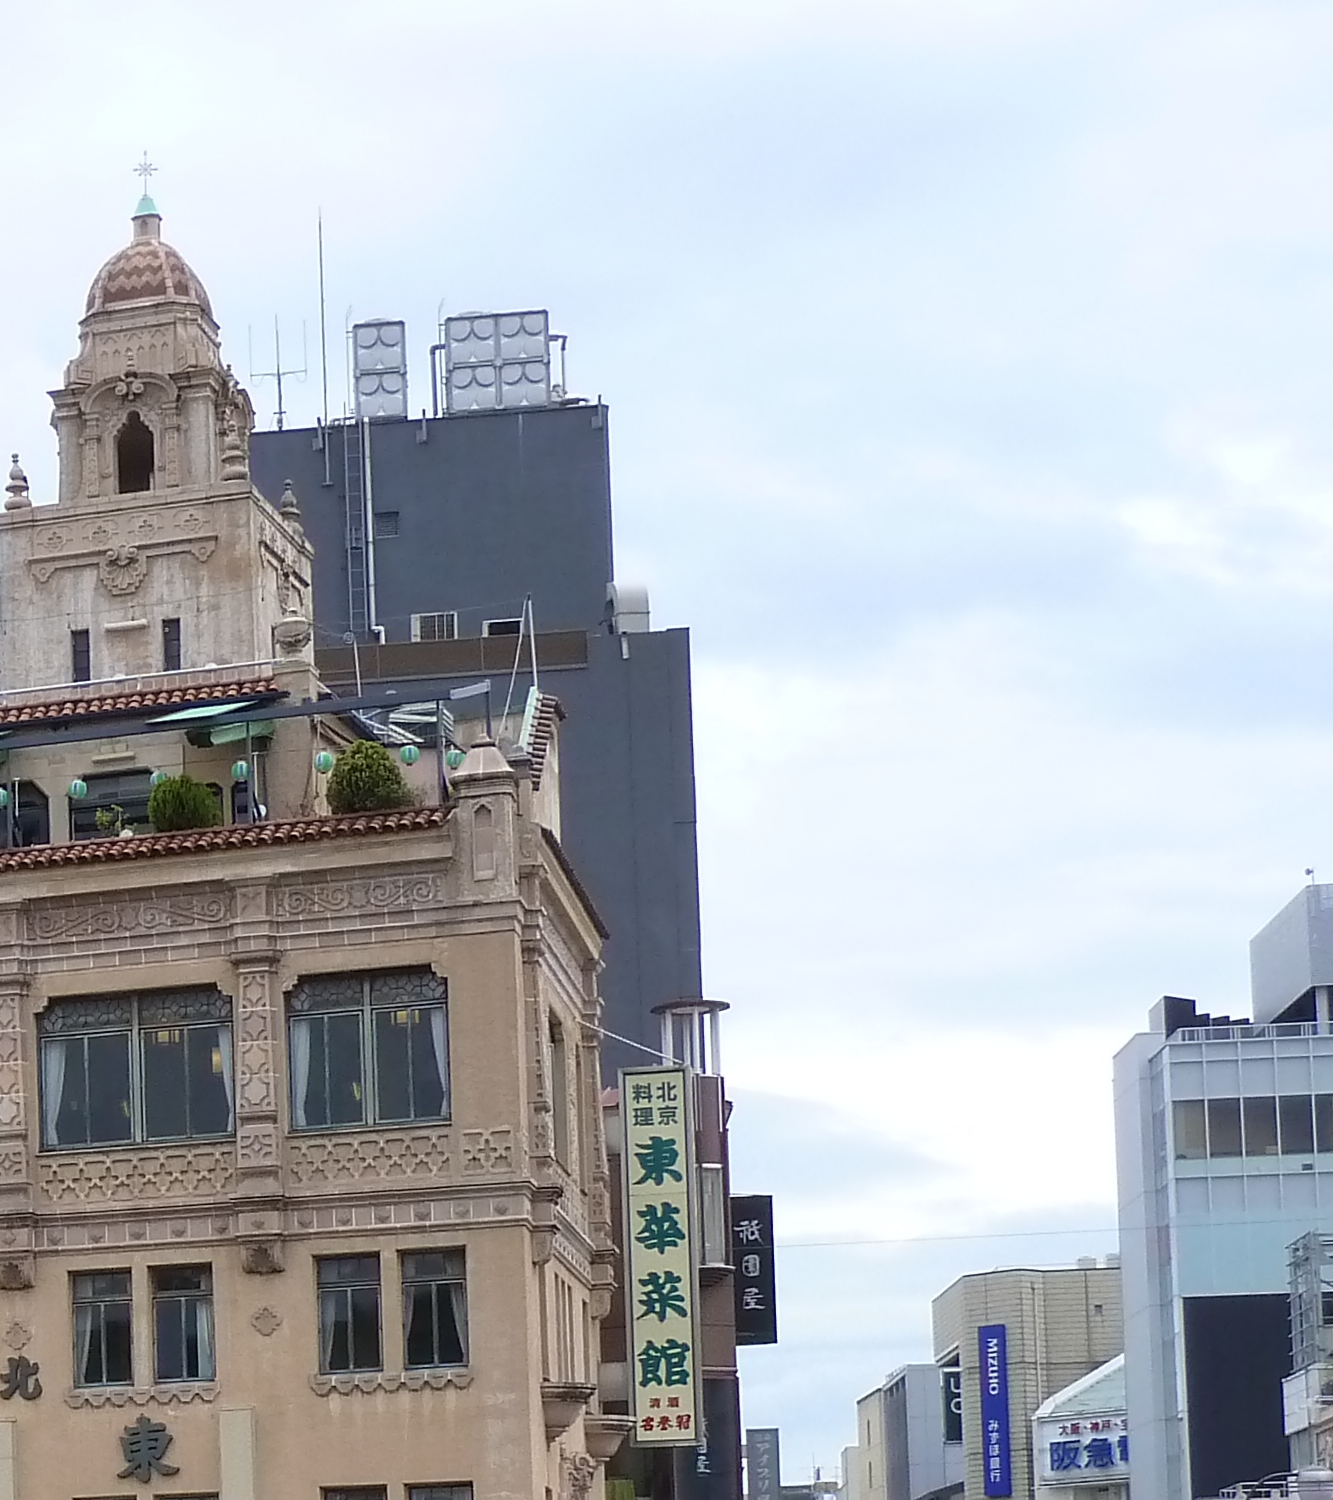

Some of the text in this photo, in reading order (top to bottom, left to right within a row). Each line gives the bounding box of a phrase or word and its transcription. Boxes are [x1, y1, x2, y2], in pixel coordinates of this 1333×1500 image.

[632, 1136, 691, 1388] 東華菜館
[986, 1337, 1000, 1396] MIZUHO
[987, 1419, 1002, 1483] みずほ銀行
